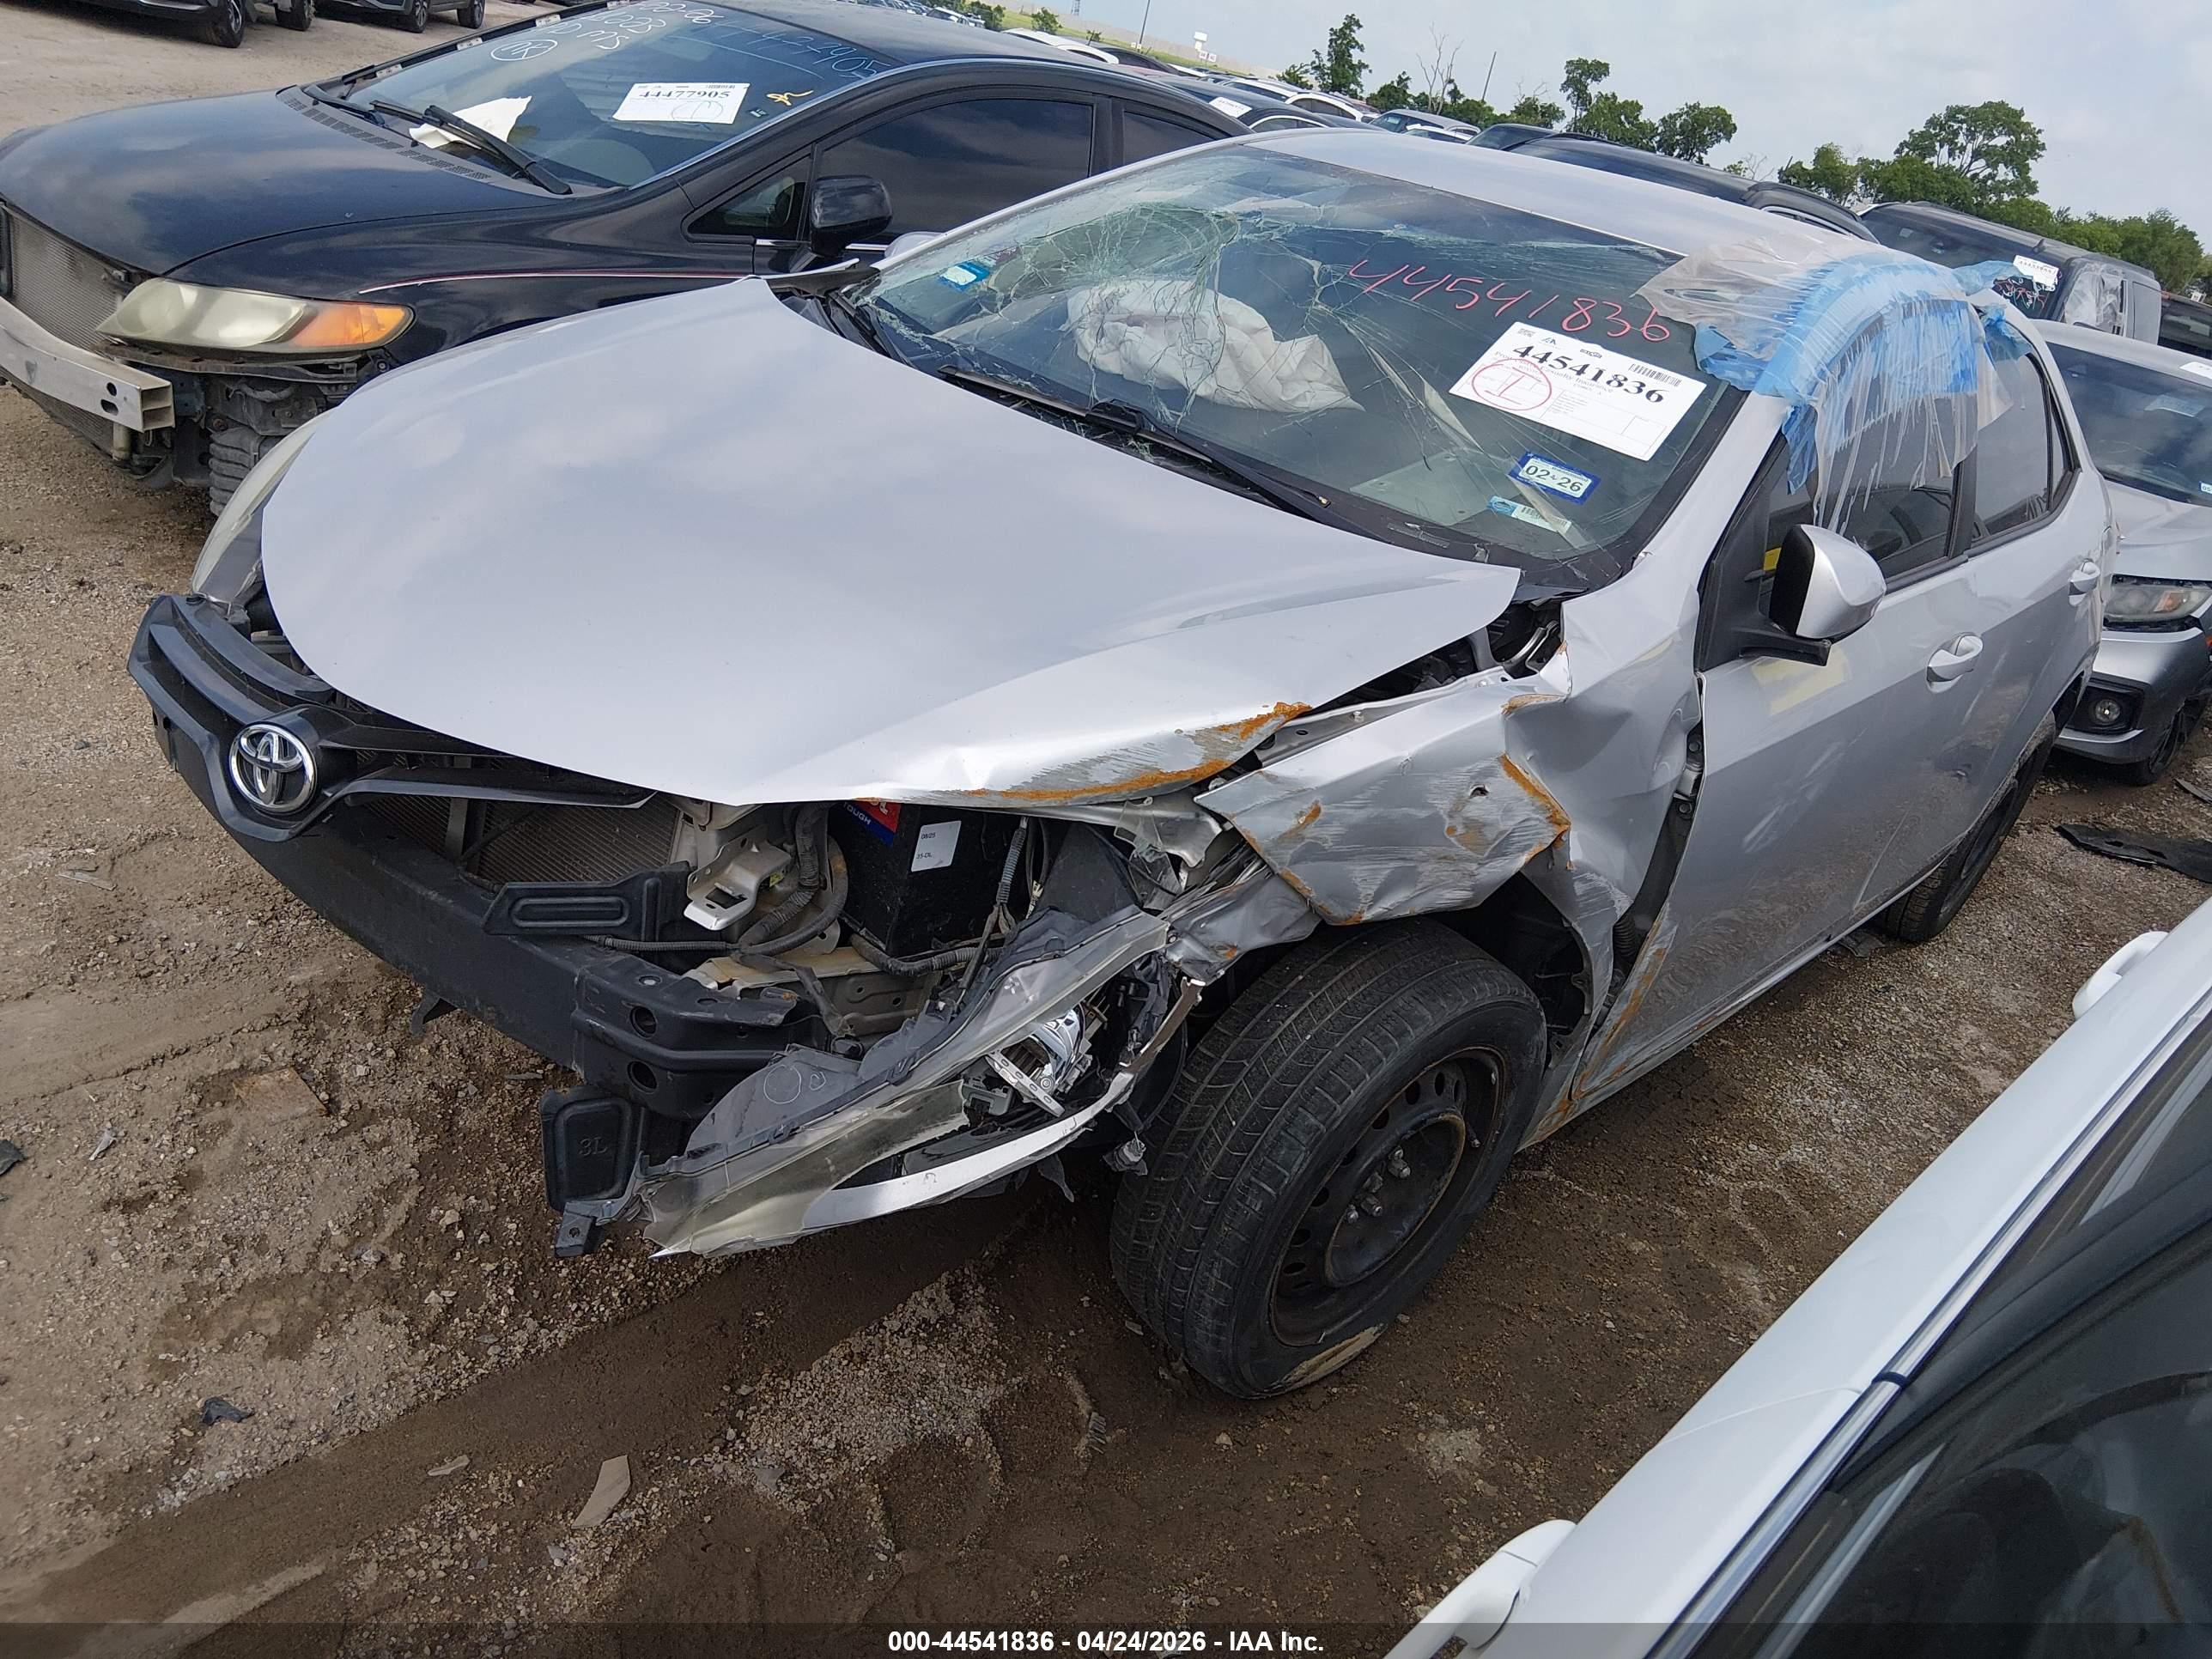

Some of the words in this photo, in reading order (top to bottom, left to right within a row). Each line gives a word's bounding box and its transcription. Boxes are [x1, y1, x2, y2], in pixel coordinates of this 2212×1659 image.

[638, 90, 731, 99] 44477905
[1348, 258, 1671, 342] 44541836
[1512, 345, 1670, 403] 44541836
[1525, 465, 1551, 480] 02
[1557, 477, 1583, 492] 26
